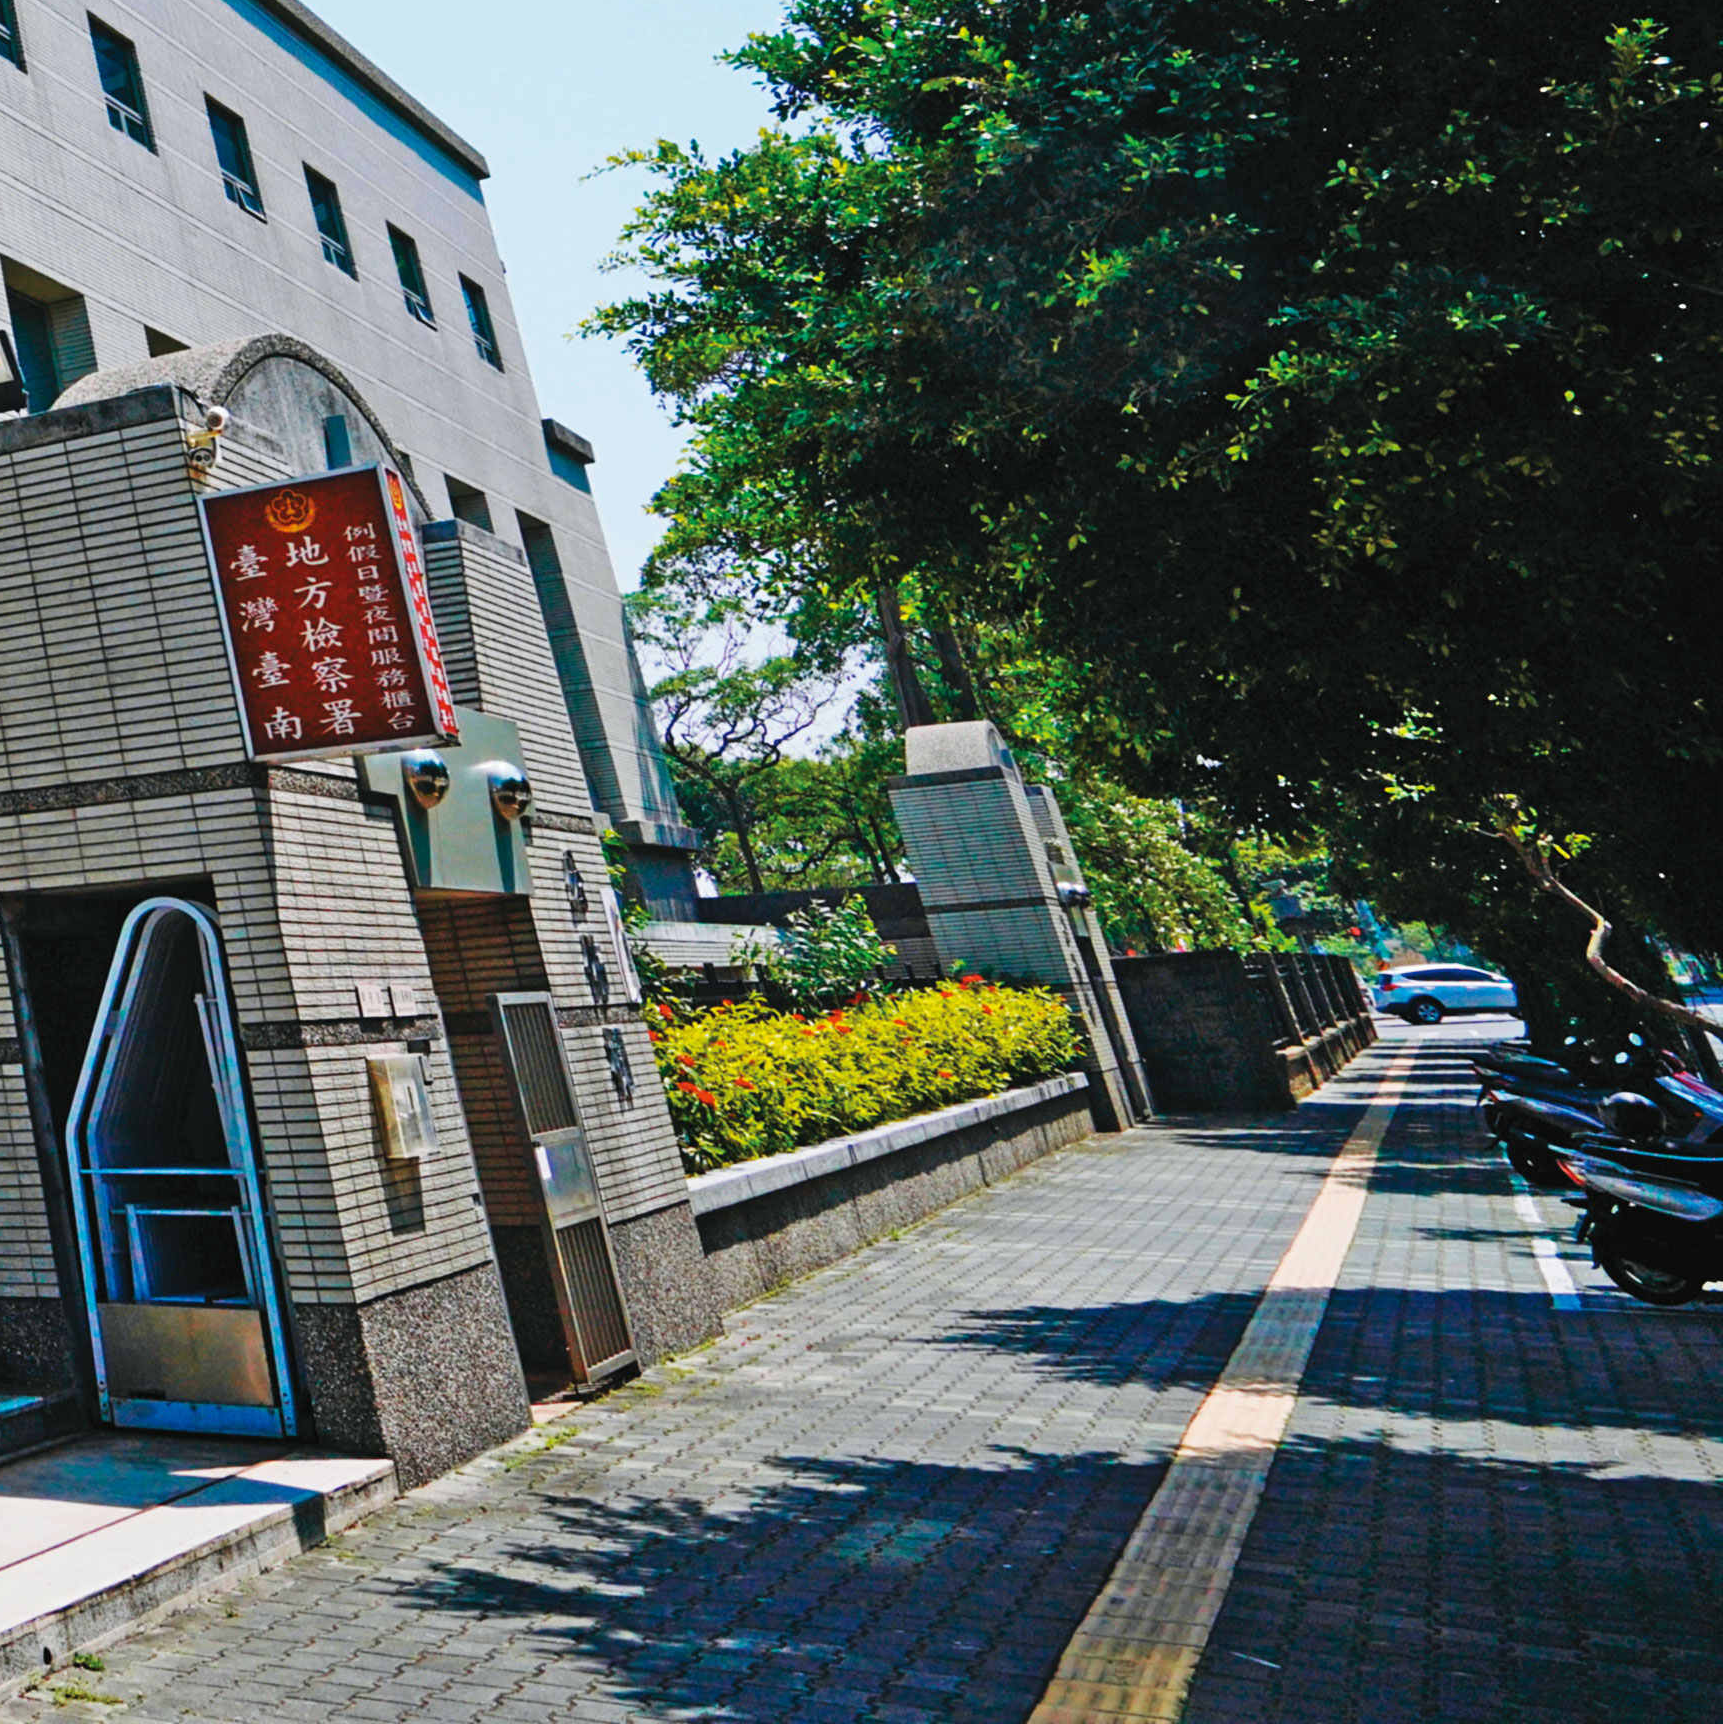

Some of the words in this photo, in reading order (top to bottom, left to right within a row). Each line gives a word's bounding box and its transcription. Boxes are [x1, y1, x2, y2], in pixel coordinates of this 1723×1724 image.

[229, 544, 303, 740] 臺灣臺南
[285, 536, 363, 735] 地方檢察署
[343, 522, 417, 730] 例假日暨夜間服務櫃台
